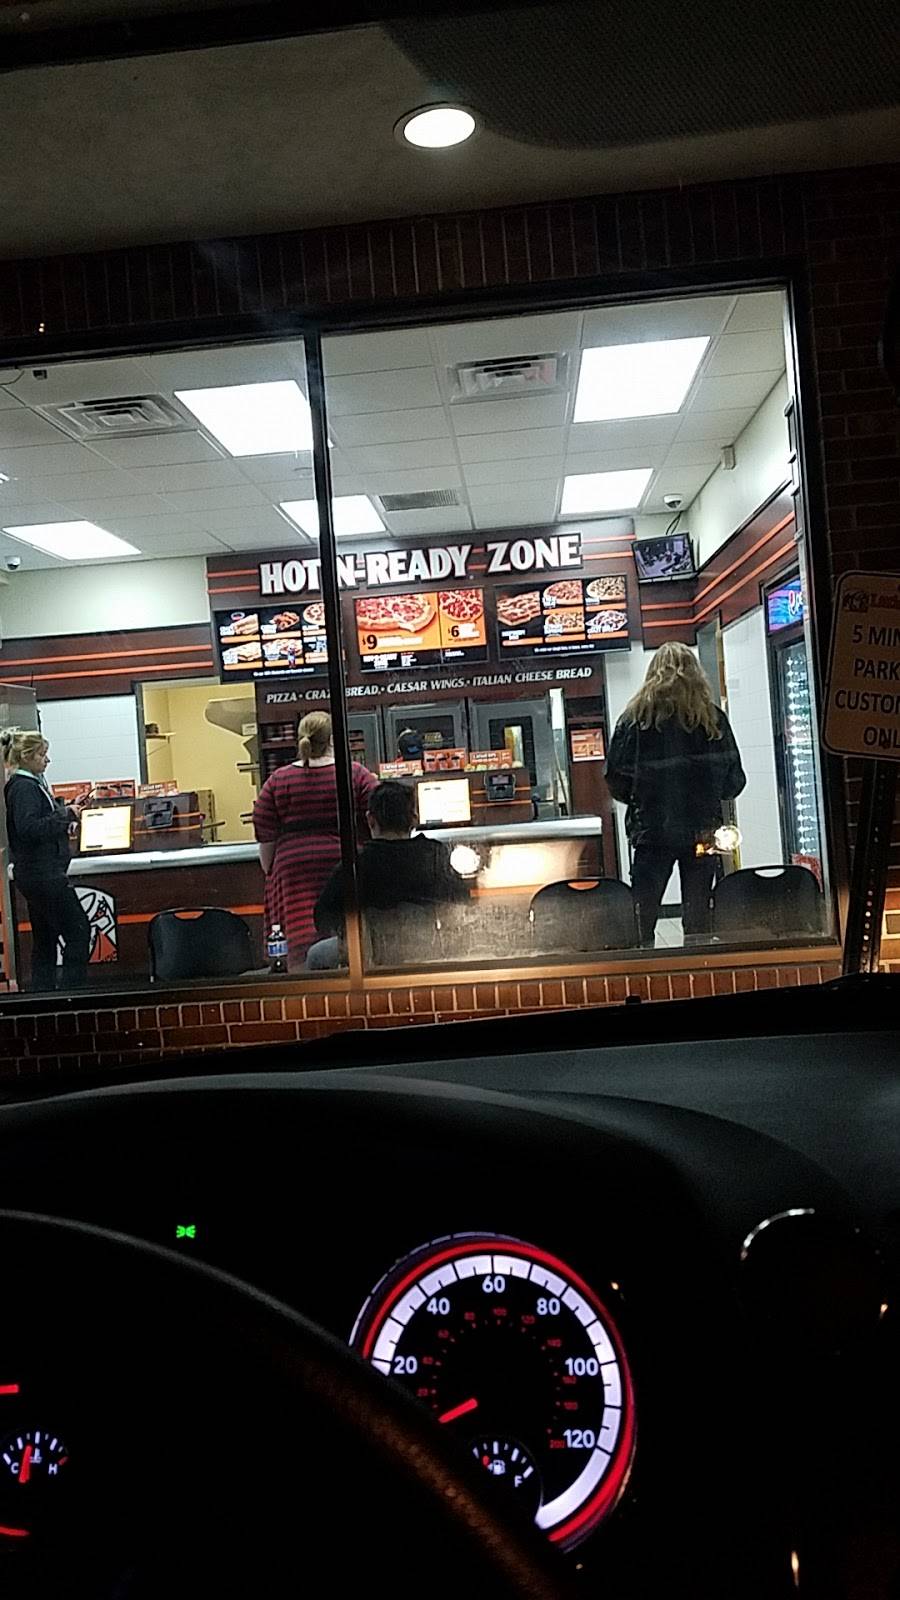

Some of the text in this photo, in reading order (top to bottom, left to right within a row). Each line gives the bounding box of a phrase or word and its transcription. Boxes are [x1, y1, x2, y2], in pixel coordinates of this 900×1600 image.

[486, 533, 582, 573] ZONE
[852, 625, 863, 644] 5
[854, 658, 900, 680] PARK
[266, 691, 297, 704] PIZZA
[386, 681, 427, 694] CAESAR
[472, 674, 512, 686] ITALIAN
[515, 670, 553, 683] CHEESE
[555, 667, 592, 680] BREAD
[482, 1275, 506, 1293] 60
[426, 1297, 450, 1315] 40
[536, 1297, 560, 1315] 80
[394, 1356, 418, 1375] 20
[565, 1357, 599, 1376] 100
[563, 1429, 595, 1448] 120
[10, 1462, 19, 1474] C
[48, 1463, 58, 1475] H
[514, 1475, 523, 1487] F
